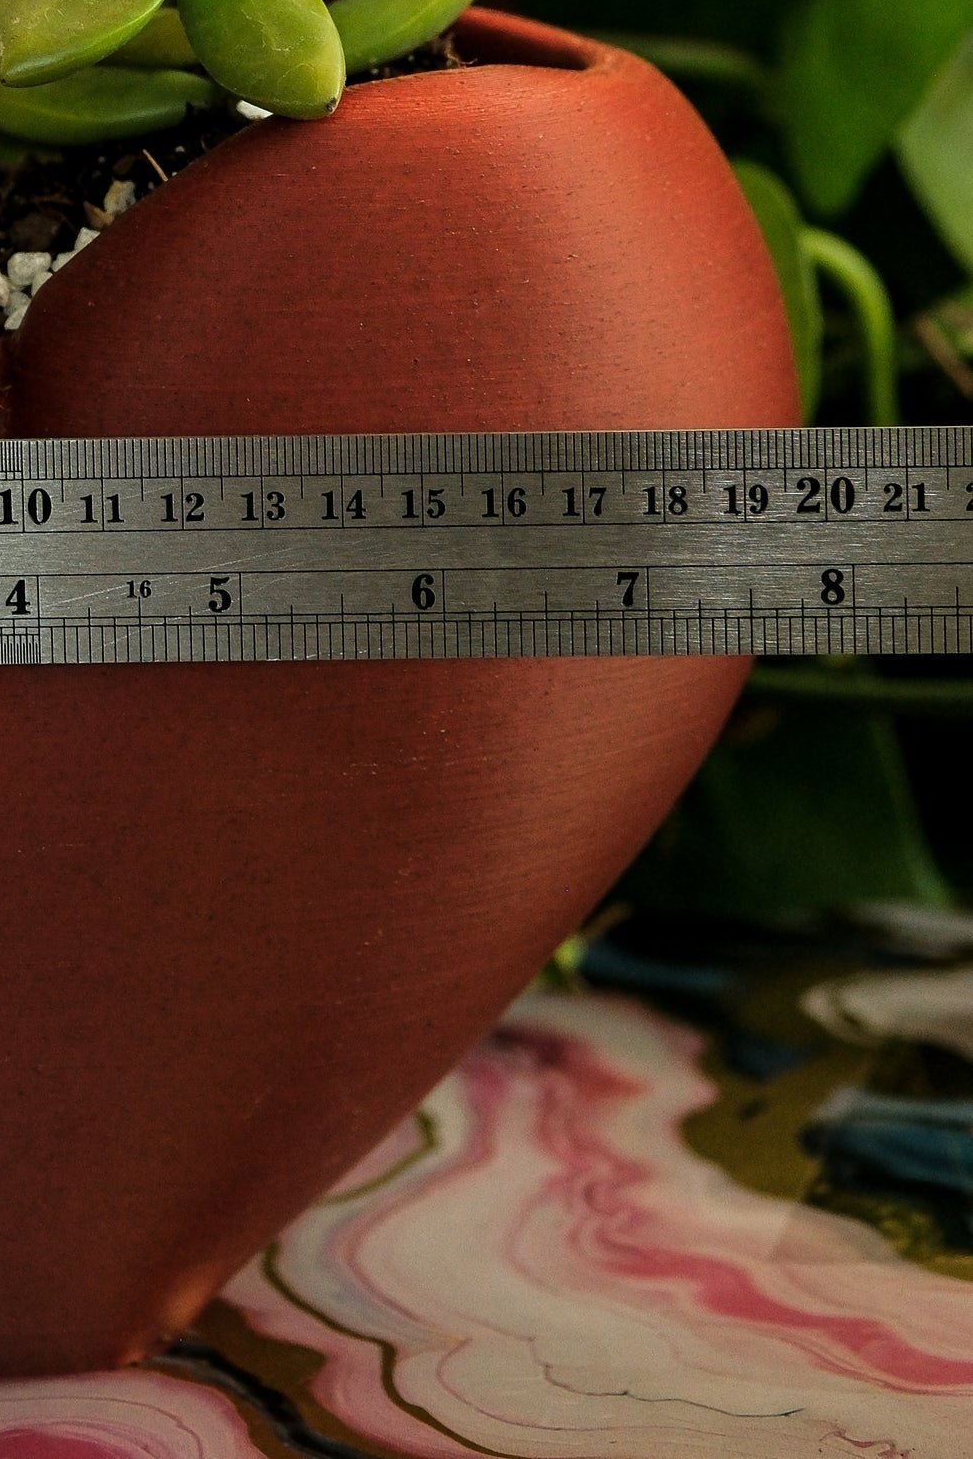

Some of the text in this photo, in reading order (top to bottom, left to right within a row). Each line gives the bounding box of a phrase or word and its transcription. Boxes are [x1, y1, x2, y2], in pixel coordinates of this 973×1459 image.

[79, 495, 126, 524] 11
[160, 492, 206, 523] 12
[240, 491, 286, 522] 13
[321, 490, 367, 520] 14
[400, 489, 446, 519] 15
[481, 488, 527, 518] 16
[561, 486, 607, 517] 17
[641, 485, 689, 516] 18
[723, 484, 770, 515] 19
[796, 476, 856, 514] 20
[882, 482, 931, 513] 21
[5, 579, 30, 616] 4
[127, 580, 152, 599] 16
[208, 576, 232, 613] 5
[411, 573, 436, 611] 6
[616, 571, 640, 607] 7
[820, 568, 845, 605] 8
